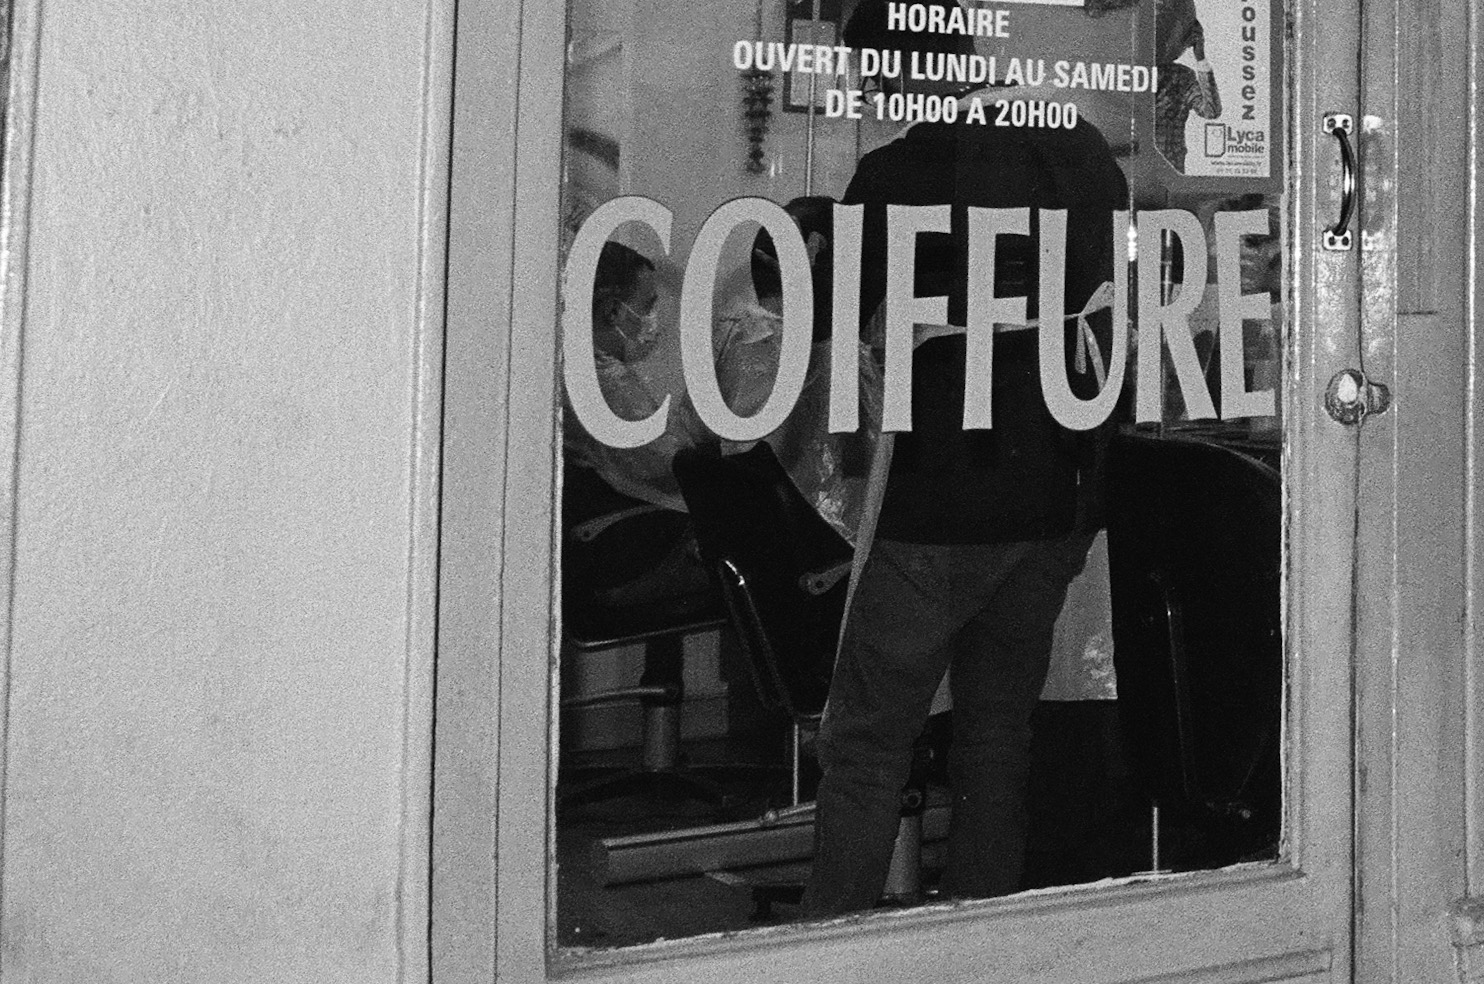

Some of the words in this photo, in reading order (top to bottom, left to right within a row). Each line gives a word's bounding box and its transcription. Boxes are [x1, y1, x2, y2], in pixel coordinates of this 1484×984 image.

[888, 2, 1010, 38] HORAIRE
[733, 40, 852, 76] OUVERT
[861, 48, 901, 78] DU
[911, 51, 996, 84] LUNDI
[1004, 58, 1045, 87] AU
[1053, 60, 1159, 93] SAMEDI
[826, 89, 862, 119] DE
[873, 92, 958, 124] 10H00
[965, 97, 987, 126] A
[994, 99, 1078, 129] 20H00
[1227, 126, 1265, 144] Lyca
[1227, 142, 1265, 154] mobile
[564, 195, 1277, 448] COIFFURE
